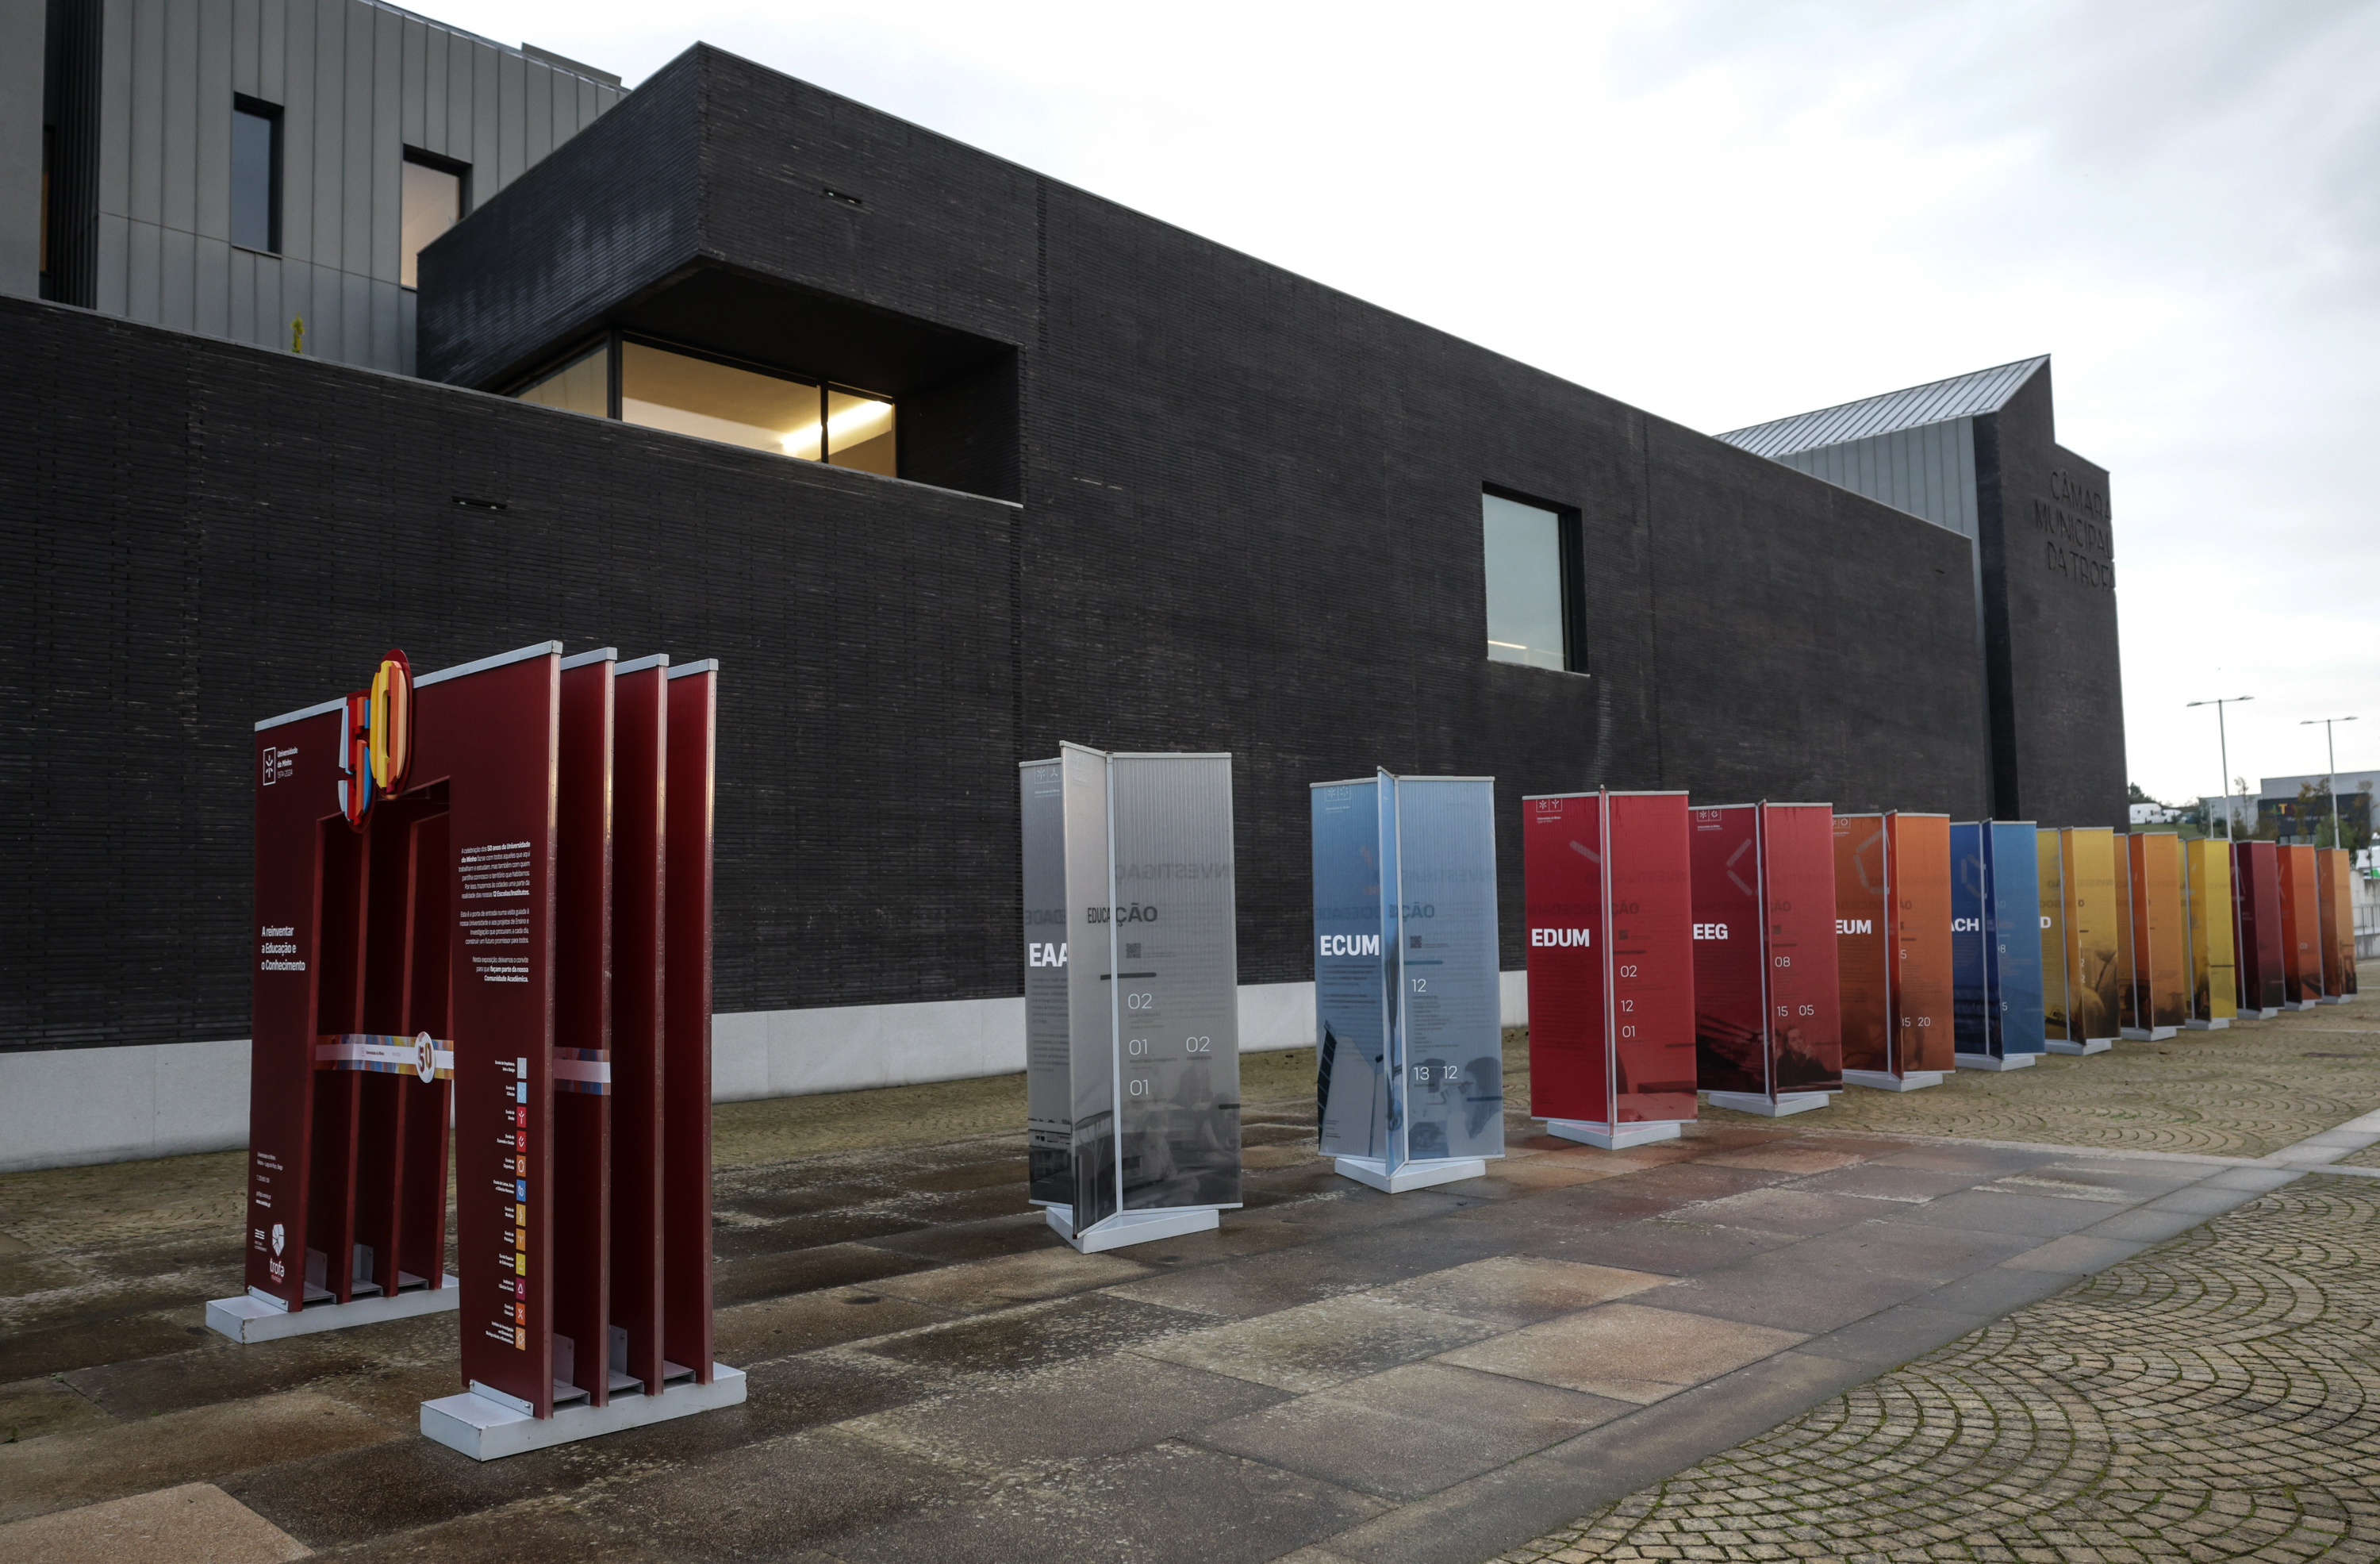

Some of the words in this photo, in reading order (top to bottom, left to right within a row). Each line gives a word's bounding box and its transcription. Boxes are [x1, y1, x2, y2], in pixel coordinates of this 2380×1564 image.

[2035, 499, 2114, 560] MUNICIPAL
[2048, 541, 2067, 578] DA
[338, 659, 408, 826] 50
[277, 746, 298, 759] Universidade
[266, 924, 294, 937] reinventar
[1531, 928, 1591, 947] EDUM
[1692, 923, 1729, 940] EEG
[266, 942, 292, 956] Educação
[292, 944, 297, 954] e
[1320, 935, 1380, 956] ECUM
[266, 959, 306, 971] Conhecimento
[1775, 956, 1791, 967] 08
[1620, 965, 1637, 978] 02
[1411, 978, 1427, 993] 12
[1127, 993, 1153, 1009] 02
[1621, 999, 1634, 1012] 12
[1776, 1005, 1789, 1017] 15
[1798, 1005, 1815, 1016] 05
[1917, 1016, 1931, 1028] 20
[1622, 1025, 1636, 1038] 01
[1129, 1039, 1148, 1055] 01
[1186, 1036, 1211, 1053] 02
[1414, 1066, 1430, 1081] 13
[1442, 1065, 1458, 1079] 12
[1130, 1079, 1149, 1096] 01
[270, 1258, 285, 1278] trofa
